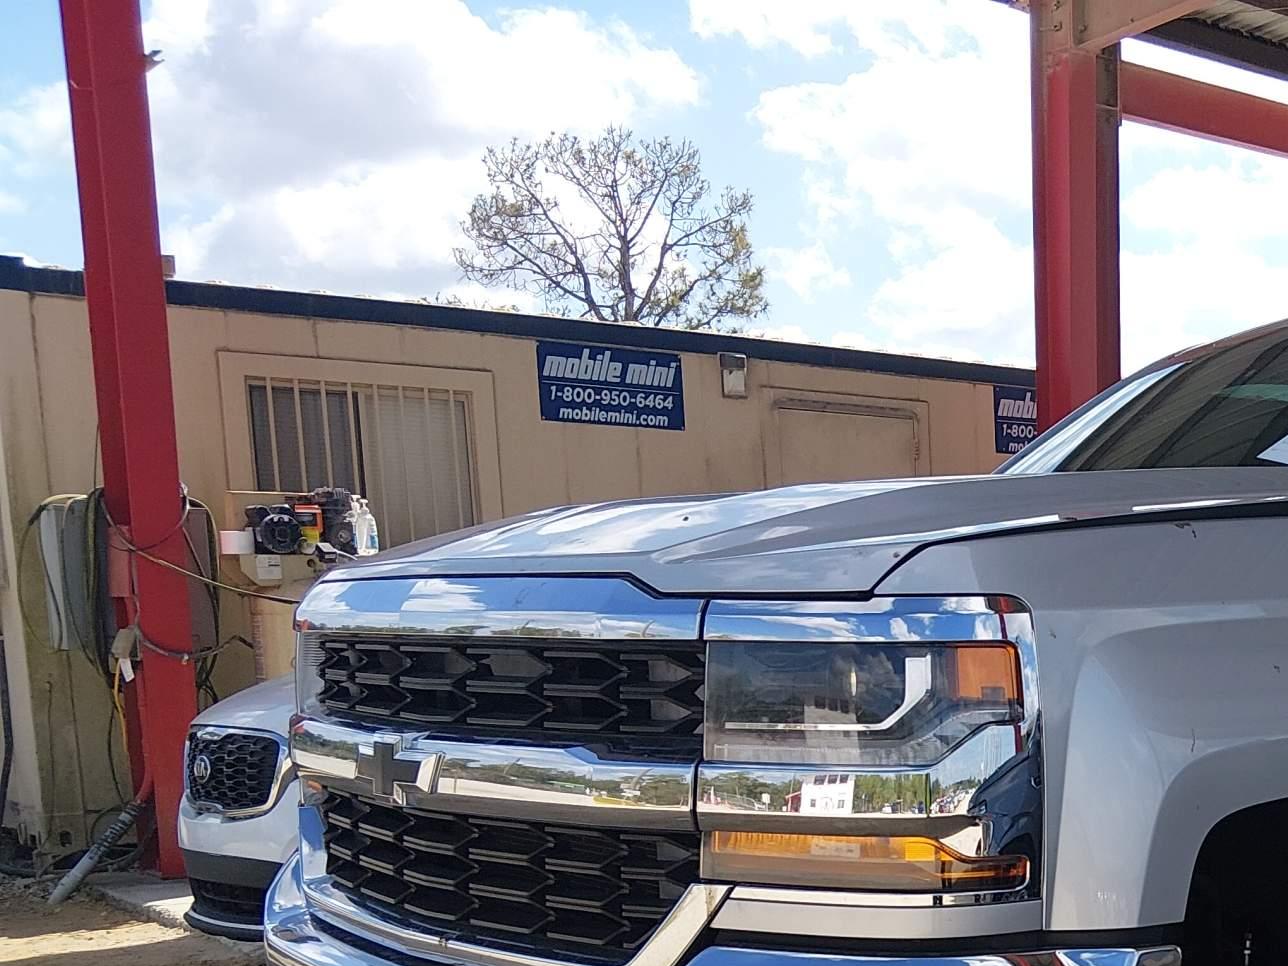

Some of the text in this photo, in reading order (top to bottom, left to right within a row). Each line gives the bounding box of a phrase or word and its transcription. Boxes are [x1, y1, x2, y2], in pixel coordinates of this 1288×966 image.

[543, 348, 677, 388] mobile mini
[550, 385, 674, 410] 1-800-950-6464
[559, 406, 669, 427] mobilemini.com
